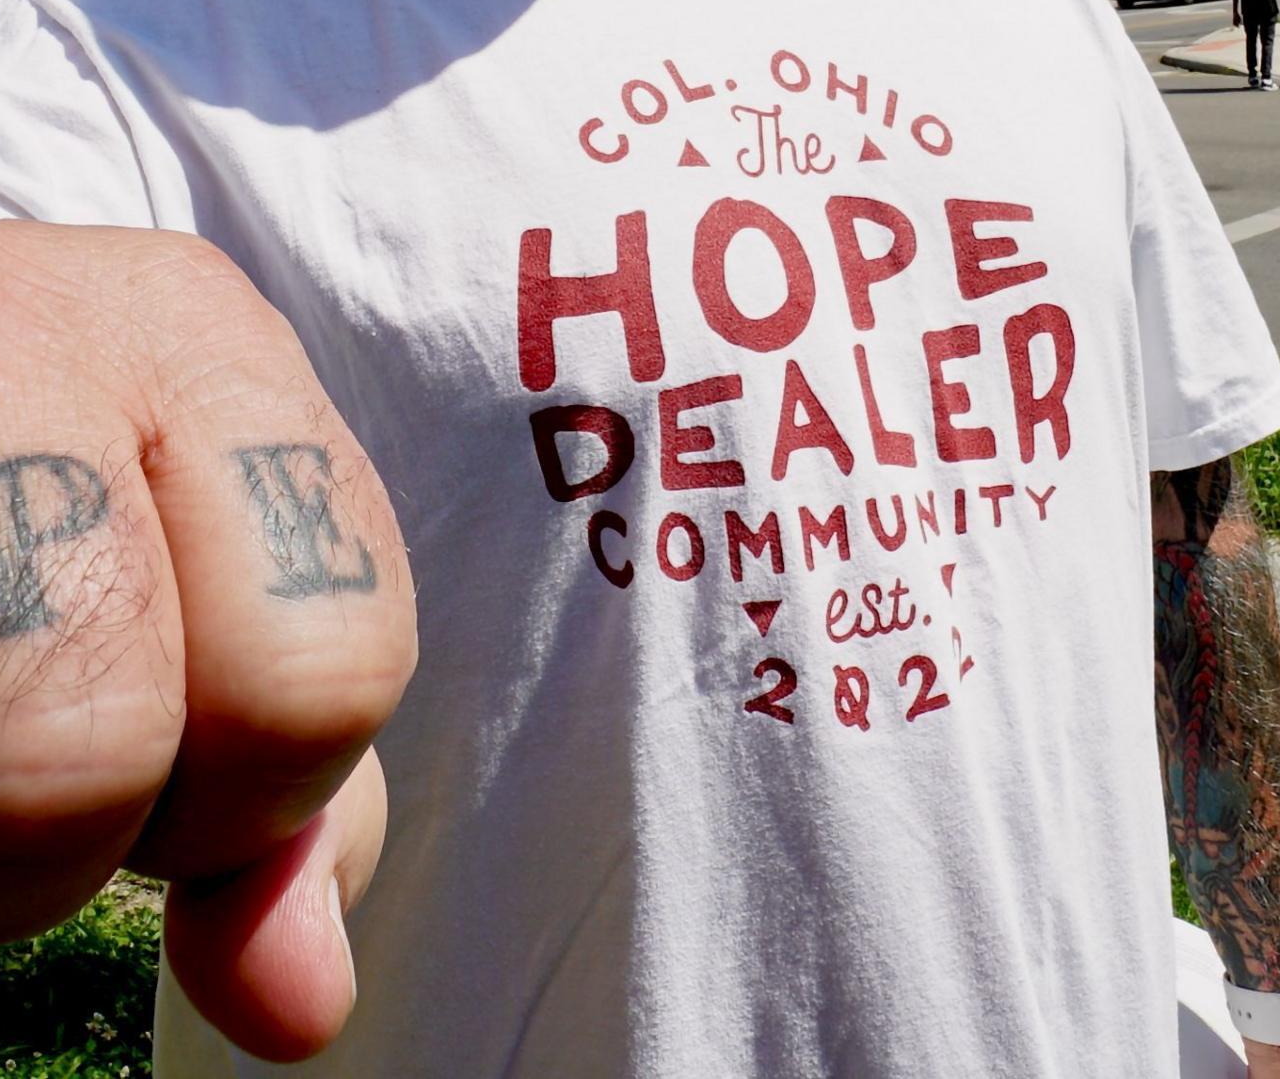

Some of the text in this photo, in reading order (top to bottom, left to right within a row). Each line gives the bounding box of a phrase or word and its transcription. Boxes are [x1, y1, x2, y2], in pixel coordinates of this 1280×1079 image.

[578, 49, 953, 164] COL. OHIO
[730, 103, 836, 178] The
[516, 194, 1049, 393] HOPE
[528, 302, 1077, 503] DEALER
[587, 484, 1058, 590] COMMUNITY
[825, 577, 933, 644] est.
